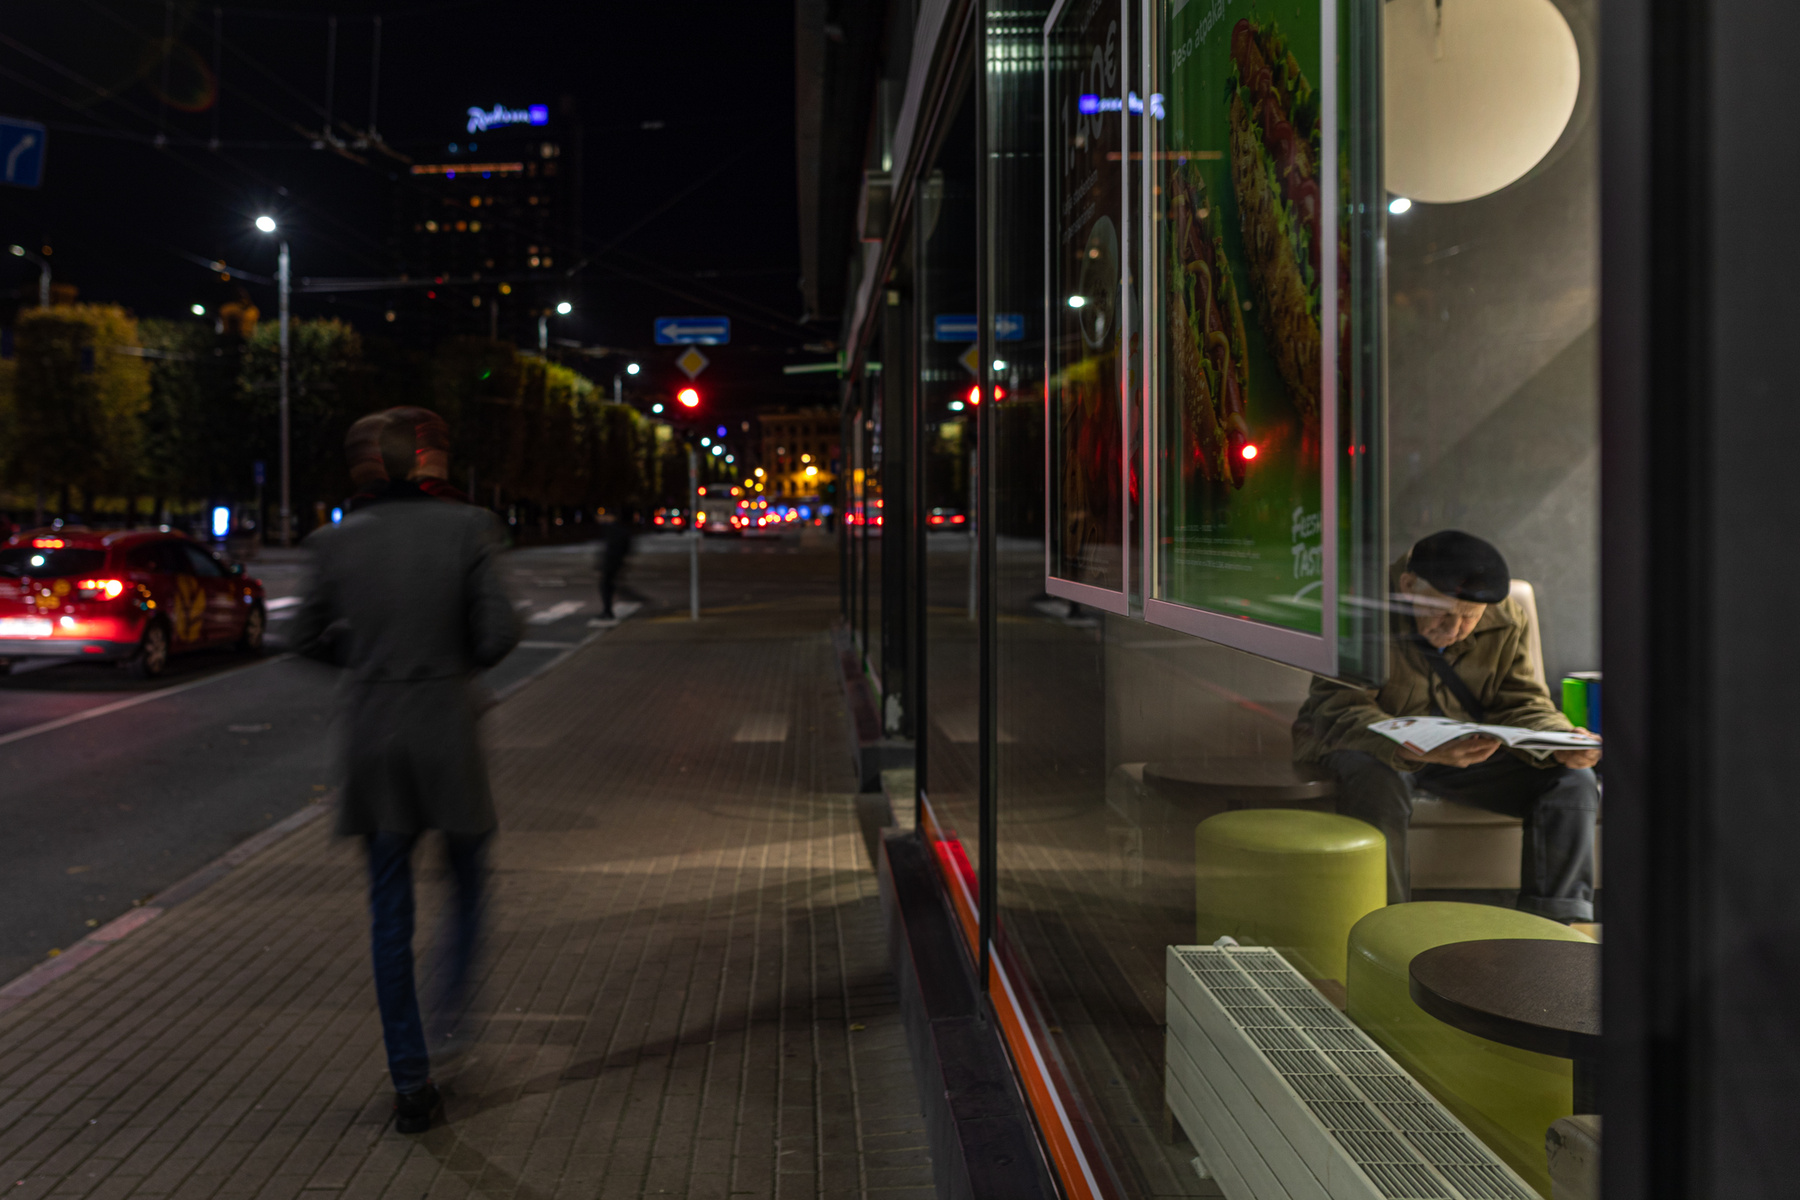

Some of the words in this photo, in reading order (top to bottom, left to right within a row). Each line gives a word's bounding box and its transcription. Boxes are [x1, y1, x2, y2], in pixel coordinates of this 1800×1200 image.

[1171, 37, 1193, 74] Deso
[1195, 0, 1232, 48] atpakaļ
[1290, 542, 1322, 579] TAST
